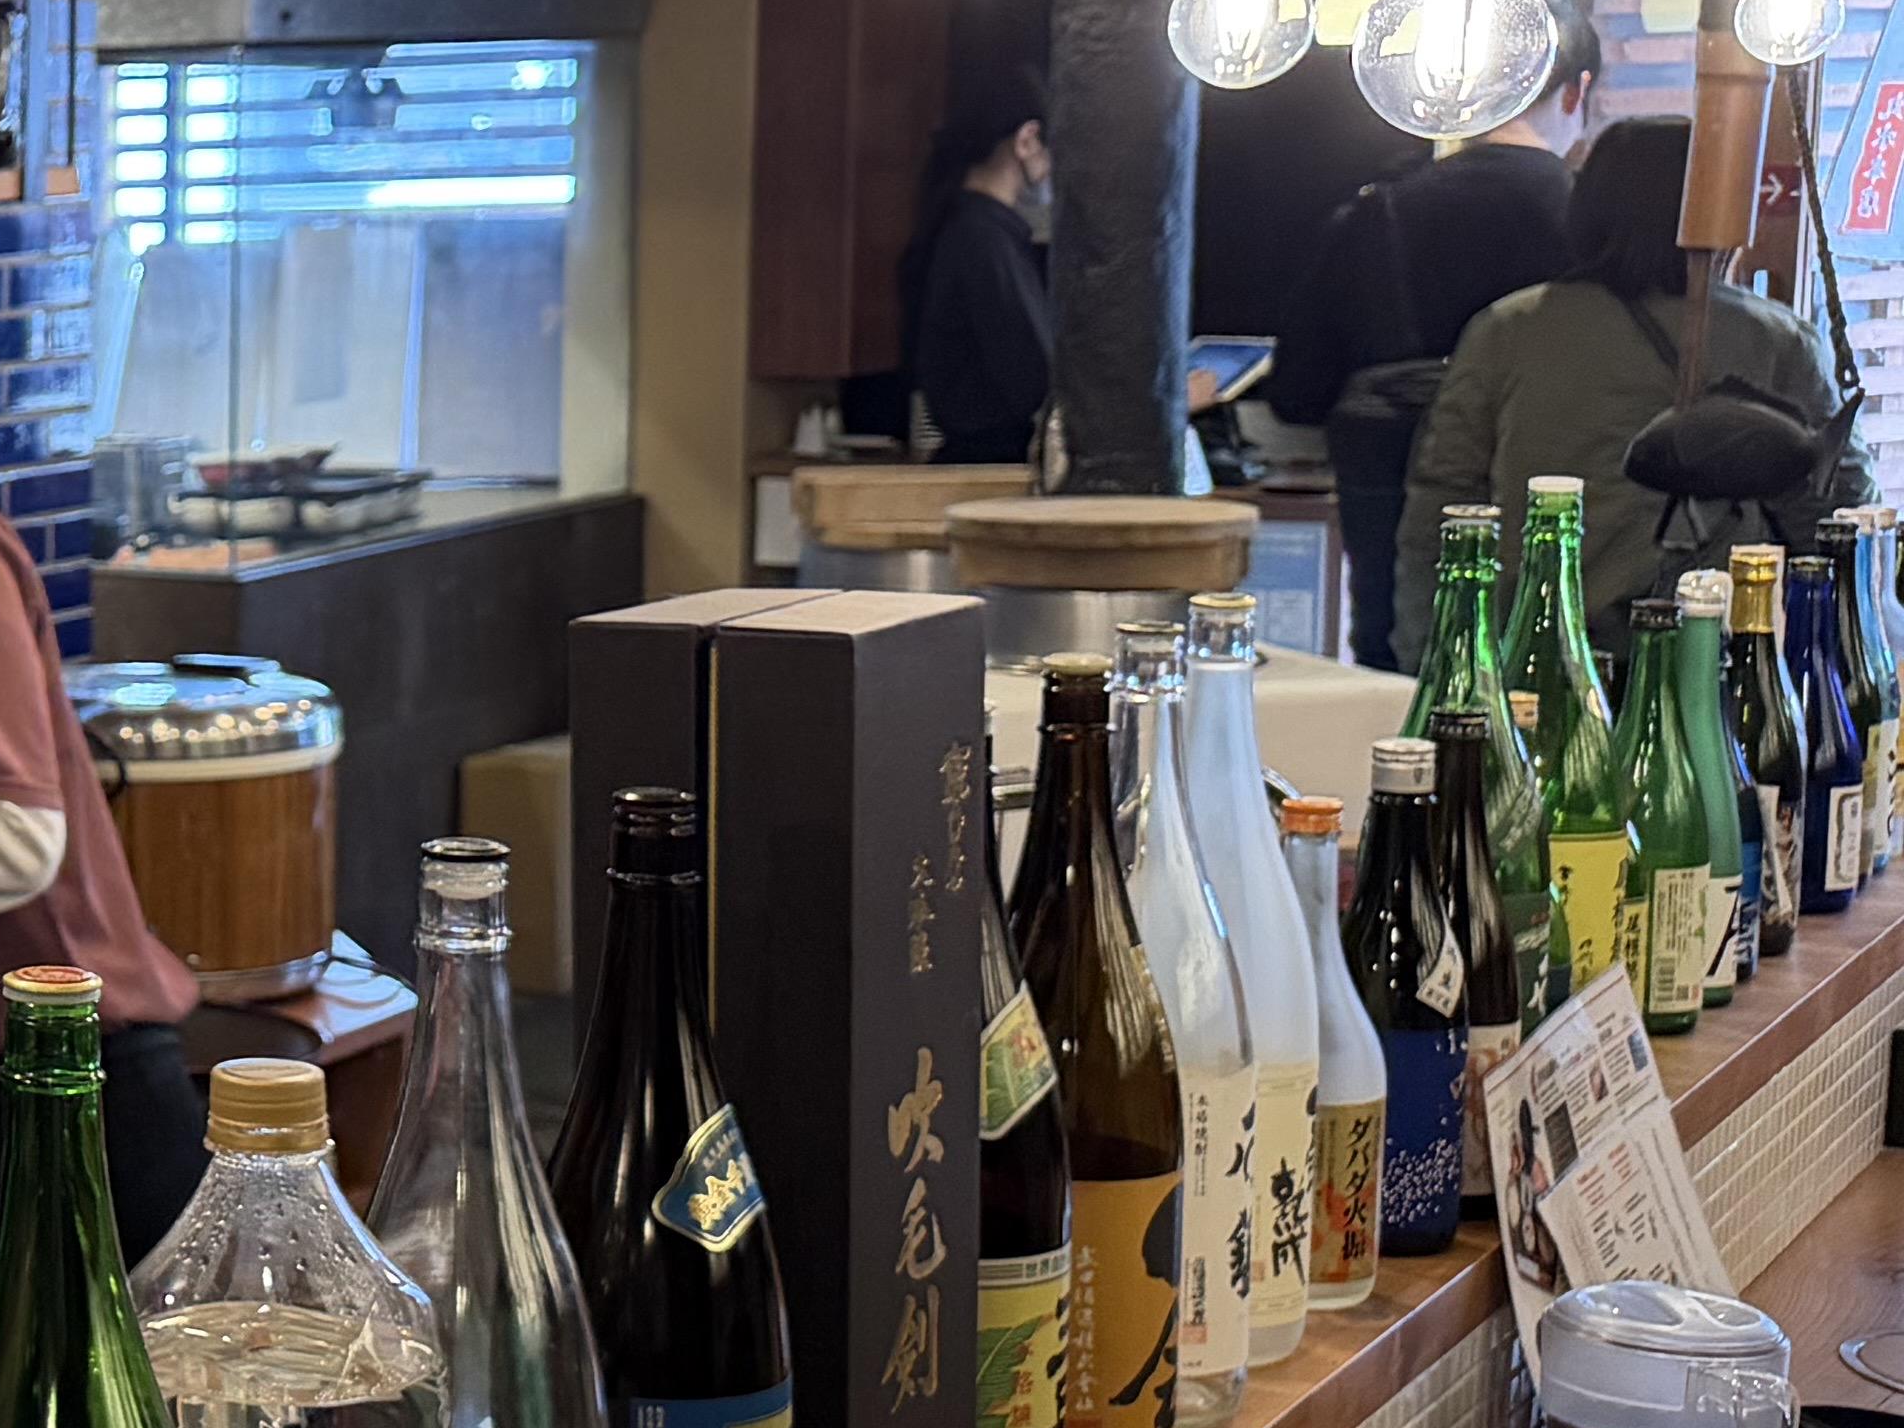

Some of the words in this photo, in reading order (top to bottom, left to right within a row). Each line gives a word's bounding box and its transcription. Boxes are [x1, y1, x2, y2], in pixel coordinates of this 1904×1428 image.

[881, 1046, 947, 1415] 吹毛剣
[1343, 1116, 1373, 1262] ダバダ火振
